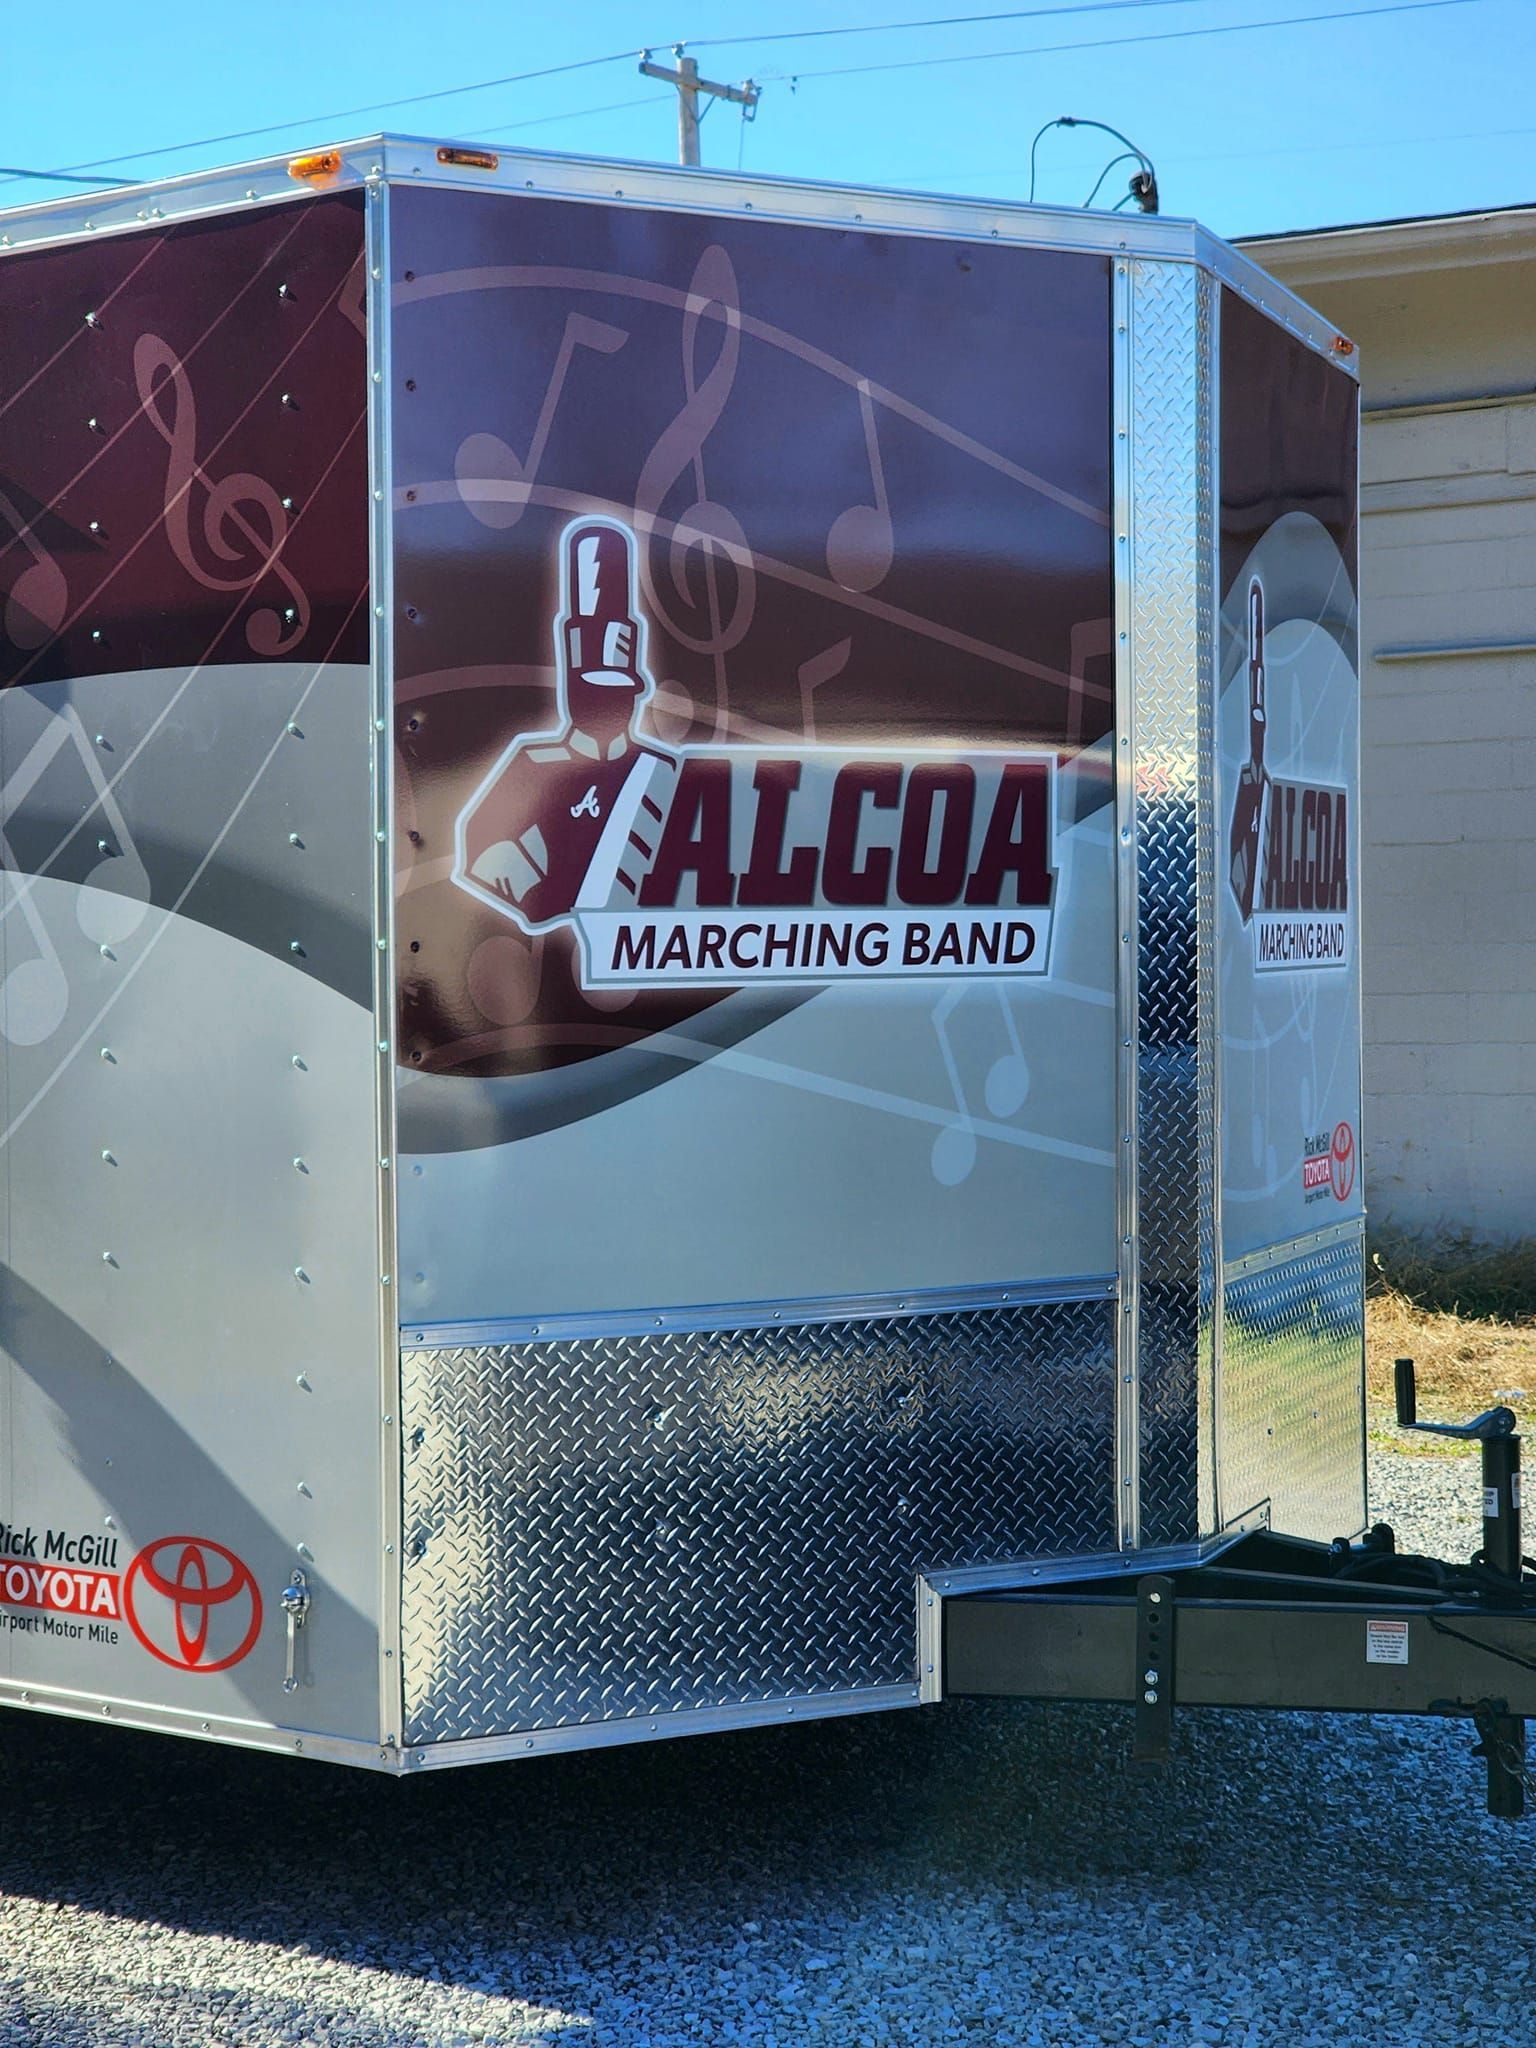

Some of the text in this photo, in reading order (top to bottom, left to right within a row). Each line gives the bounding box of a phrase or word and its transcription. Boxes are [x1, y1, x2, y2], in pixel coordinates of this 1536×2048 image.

[570, 785, 600, 818] A
[637, 758, 1052, 907] ALCOA
[1264, 785, 1347, 911] ALCOA
[611, 921, 1036, 971] MARCHING BAND
[1259, 923, 1345, 962] MARCHING BAND
[1304, 1158, 1330, 1186] TOYOTA
[44, 1530, 118, 1568] McGill
[44, 1616, 84, 1639] Motor
[88, 1623, 119, 1645] Mile
